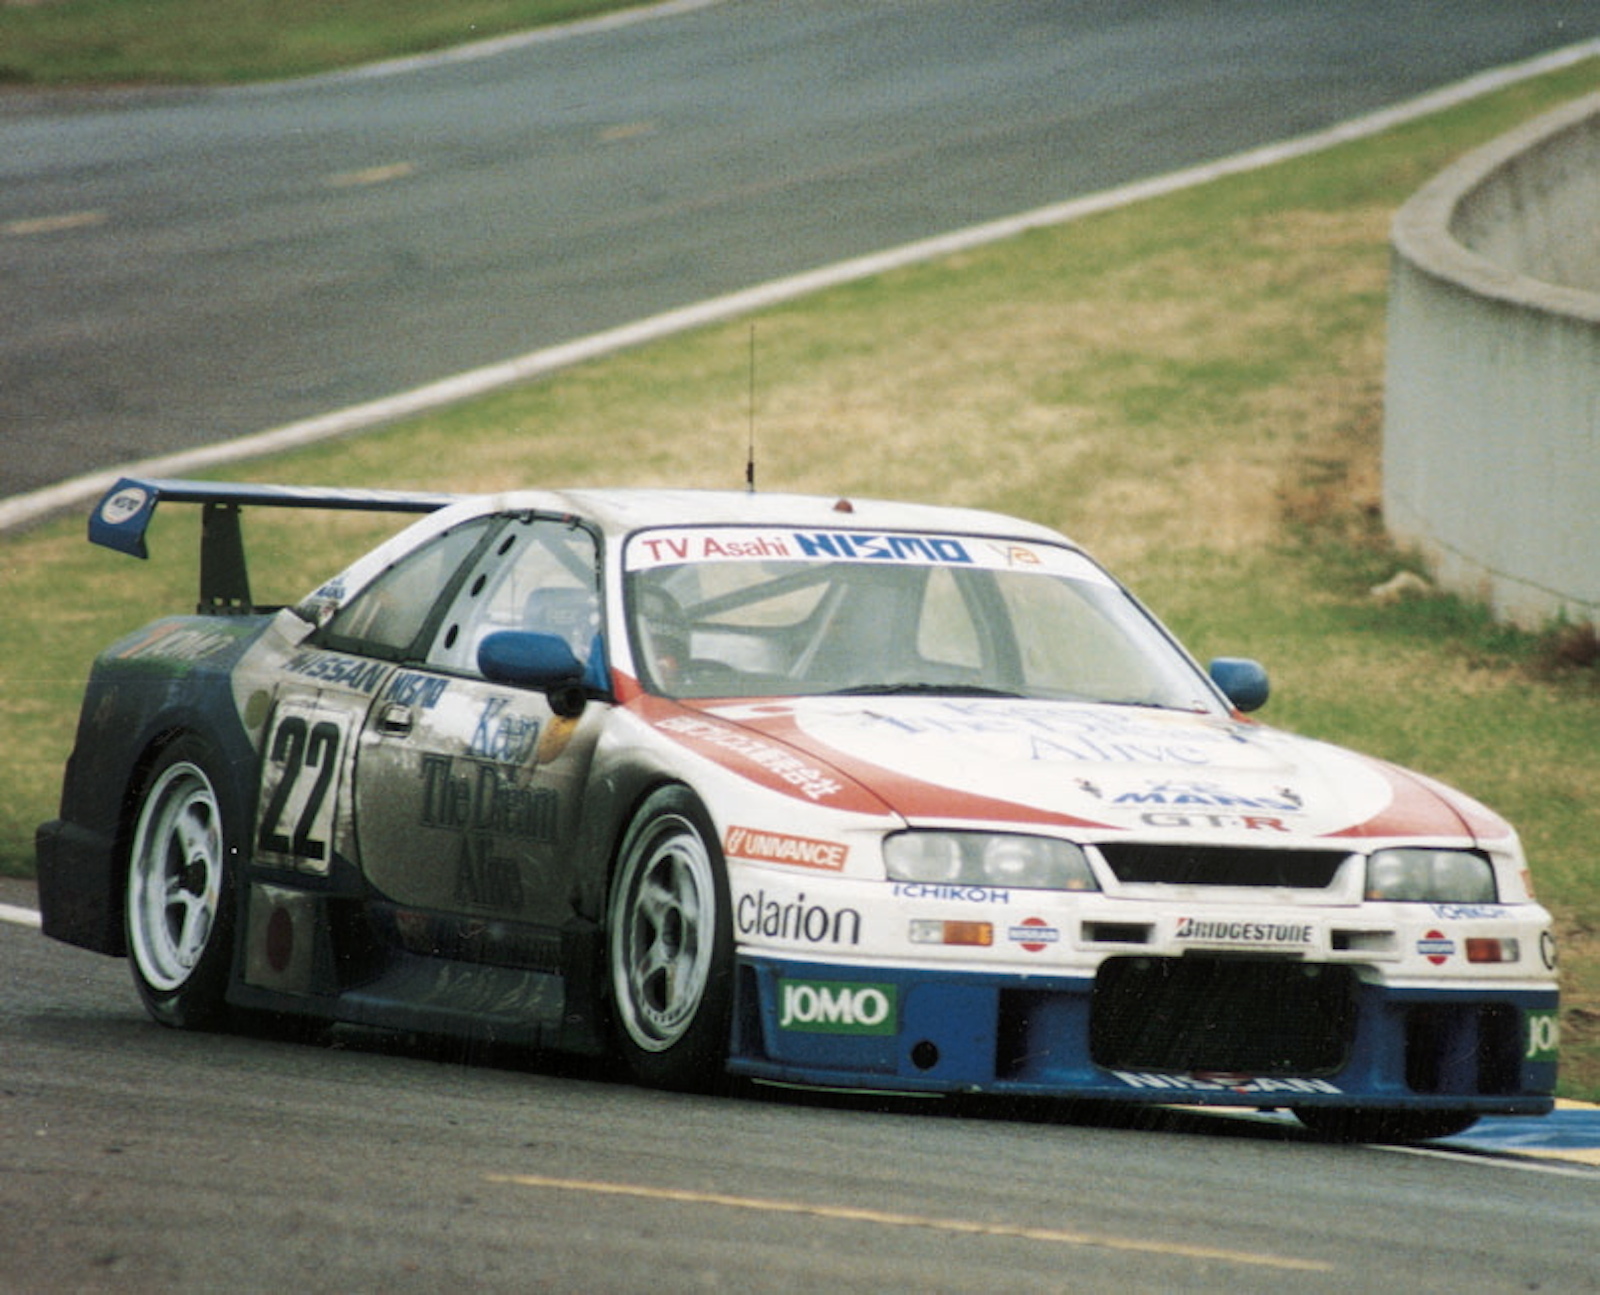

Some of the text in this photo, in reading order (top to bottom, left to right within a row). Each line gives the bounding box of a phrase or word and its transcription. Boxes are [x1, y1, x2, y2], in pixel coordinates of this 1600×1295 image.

[642, 537, 791, 561] TV Asahi
[793, 533, 975, 564] NISMO
[280, 653, 389, 693] NISSAN
[259, 715, 340, 861] 22
[421, 753, 470, 830] The
[744, 832, 845, 867] UNIVANCE
[893, 884, 1010, 904] ICHIKOH
[737, 889, 861, 945] Clarion
[1175, 917, 1313, 942] BRIDGESTONE
[779, 984, 890, 1027] JOMO
[1525, 1014, 1559, 1059] JO
